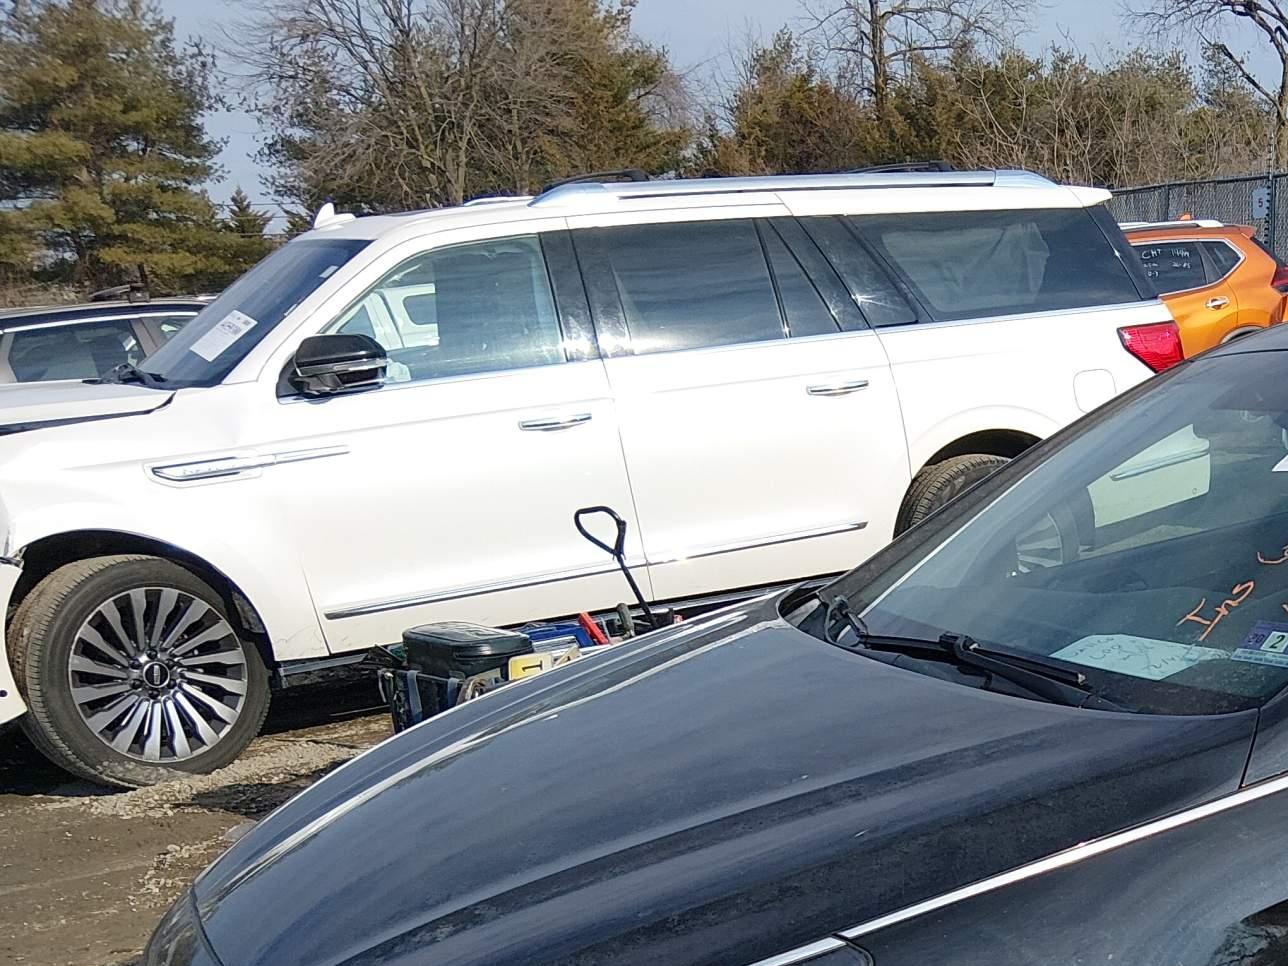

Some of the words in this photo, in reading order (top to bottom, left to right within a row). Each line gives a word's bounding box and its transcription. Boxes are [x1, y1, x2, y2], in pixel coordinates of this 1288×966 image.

[1258, 198, 1264, 208] 5
[1176, 579, 1256, 643] Ins
[1248, 632, 1266, 644] 20
[1269, 634, 1286, 650] 2
